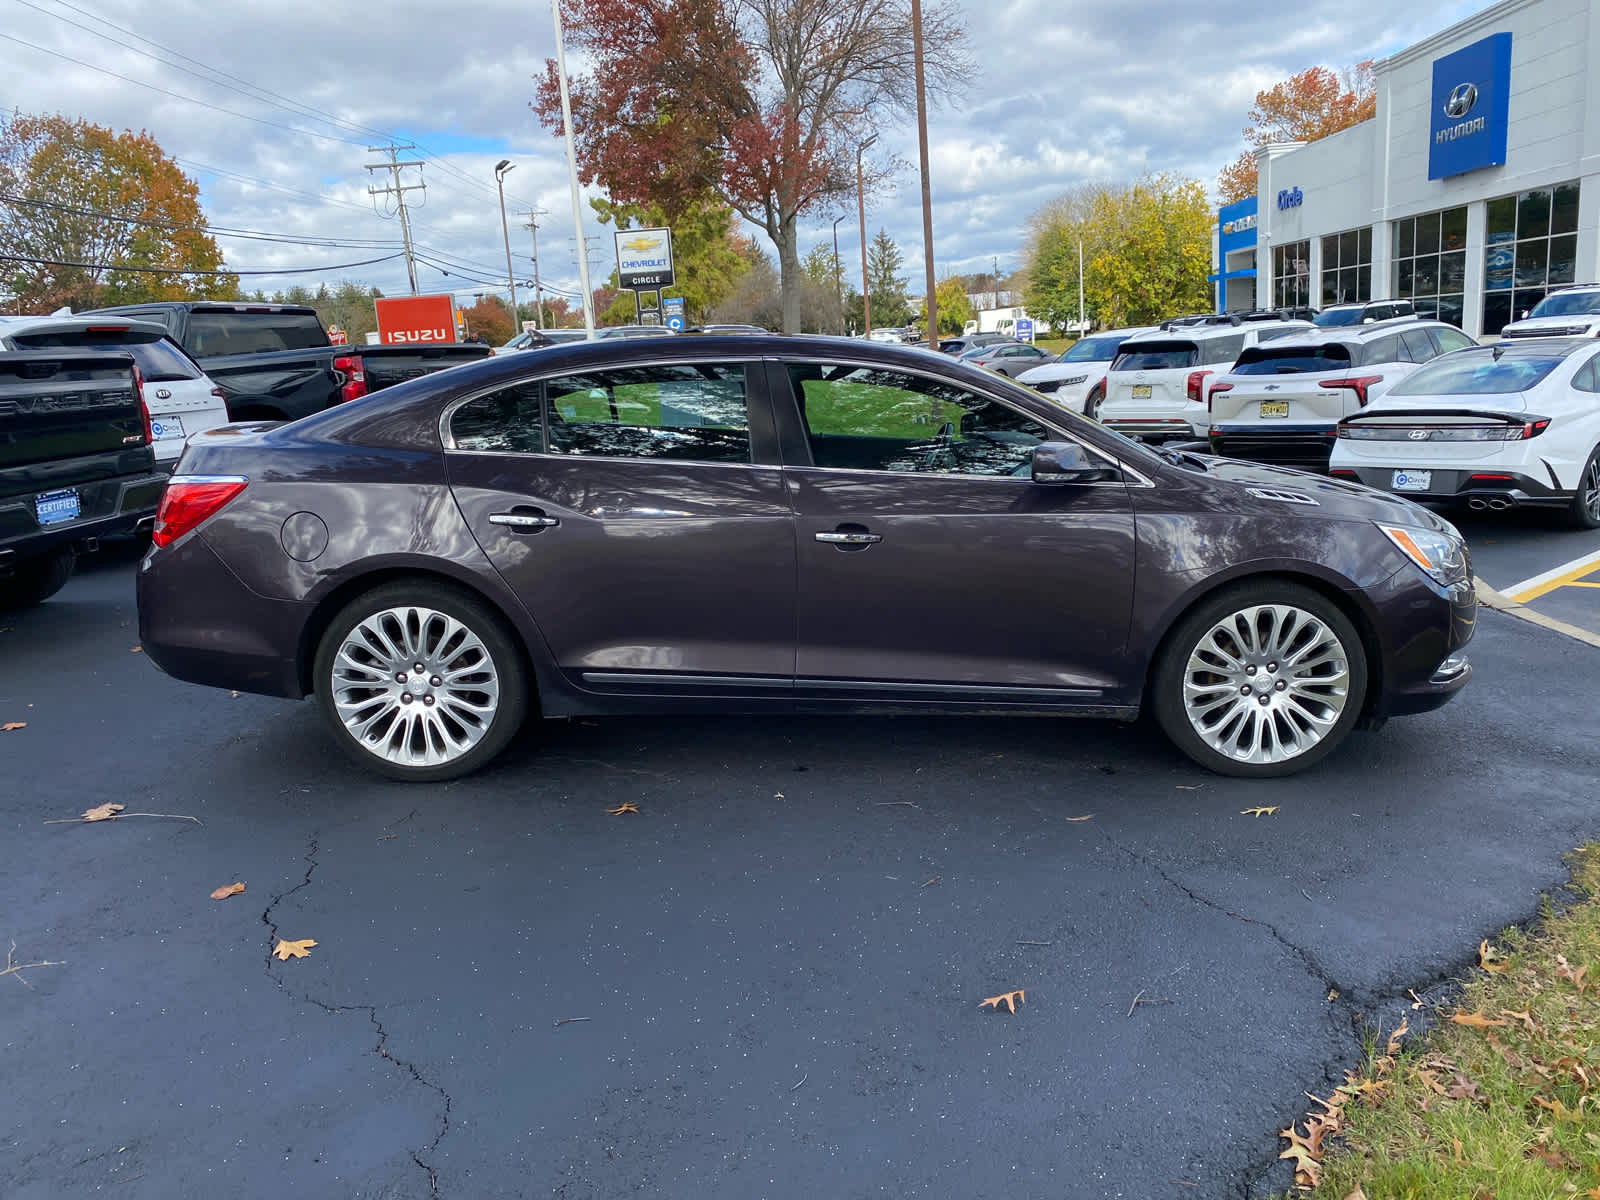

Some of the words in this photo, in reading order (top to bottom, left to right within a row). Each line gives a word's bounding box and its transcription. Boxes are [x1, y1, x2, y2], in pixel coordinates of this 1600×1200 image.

[1436, 116, 1485, 144] HYUNDAI
[1278, 186, 1303, 211] Circle
[621, 258, 667, 269] CHEVROLET
[632, 275, 661, 285] CIRCLE
[387, 328, 446, 343] ISUZU
[38, 498, 78, 514] CERTIFIED
